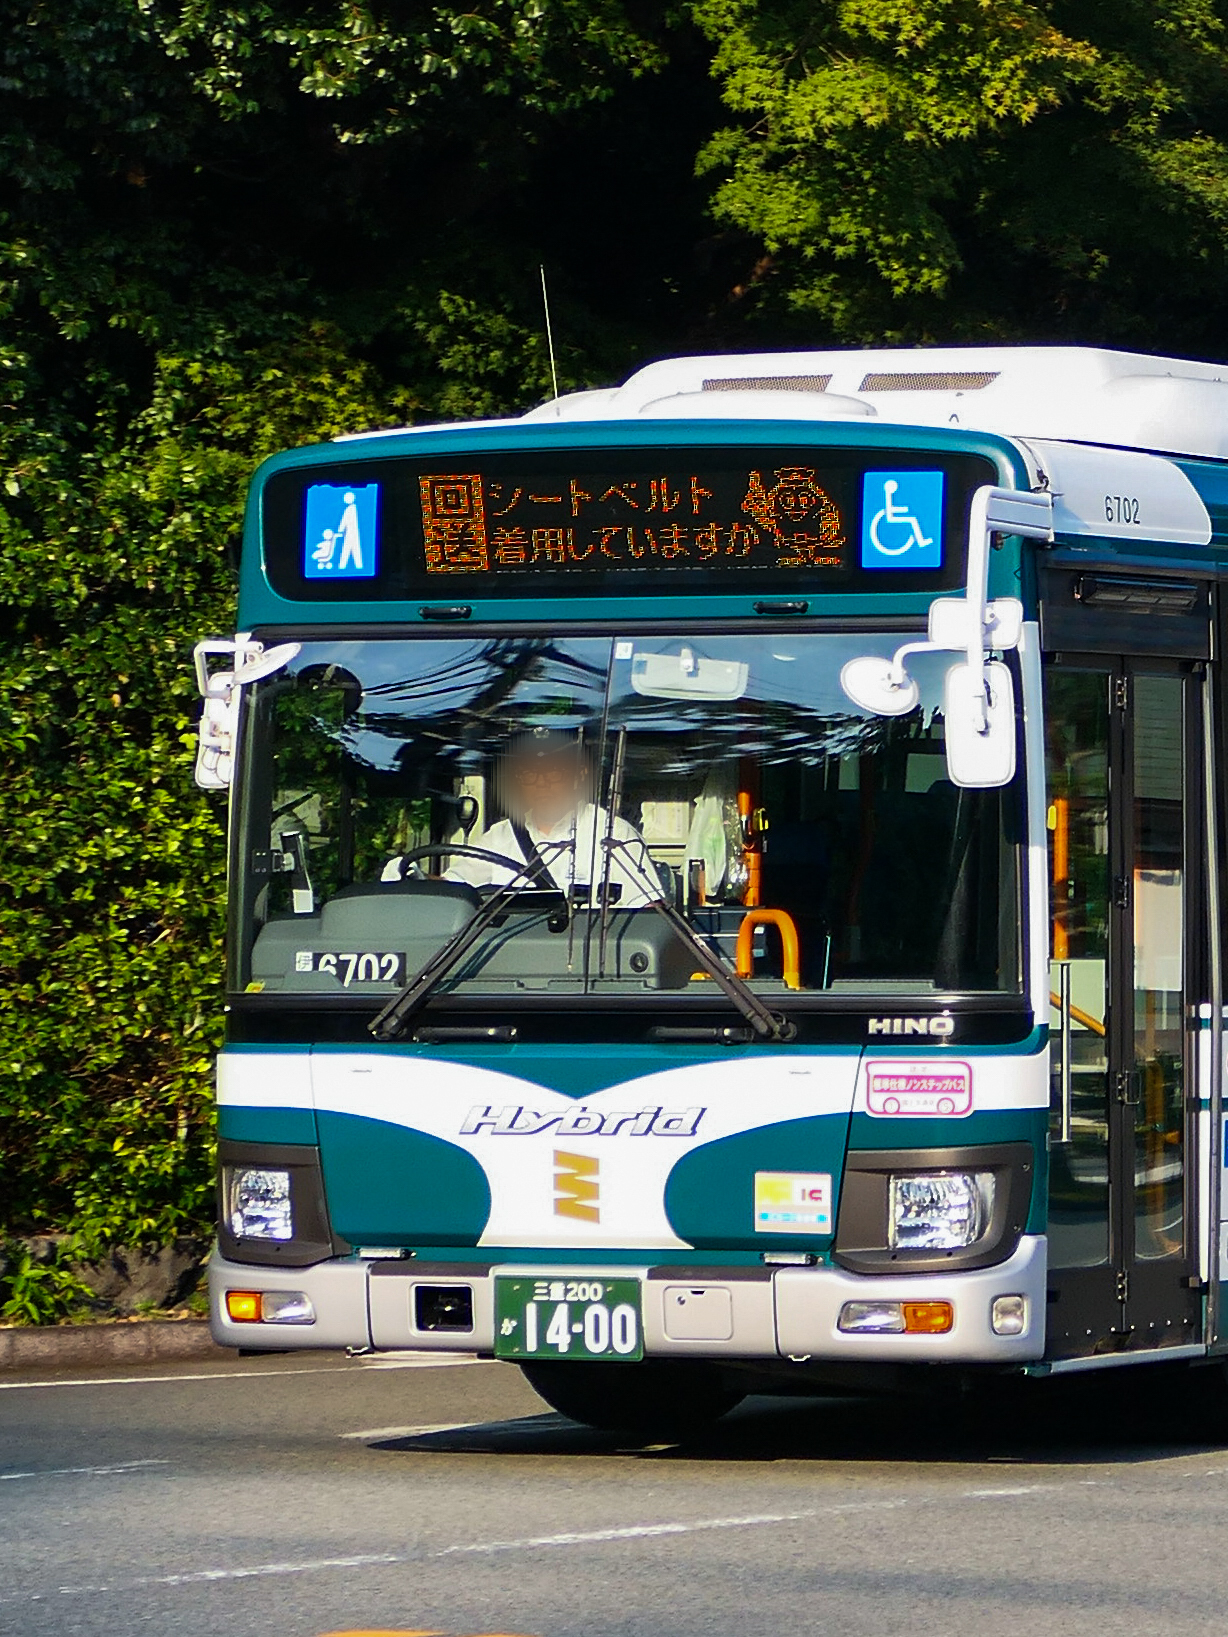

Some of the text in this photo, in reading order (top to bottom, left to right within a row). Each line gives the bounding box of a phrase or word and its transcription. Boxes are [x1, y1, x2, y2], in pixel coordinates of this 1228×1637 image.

[489, 476, 713, 517] シートベルト
[1104, 495, 1141, 525] 6702
[490, 521, 761, 564] 着用していますか
[318, 953, 400, 988] 6702
[868, 1017, 954, 1036] HINO
[459, 1105, 708, 1137] Hybrid
[526, 1302, 636, 1354] 14-00
